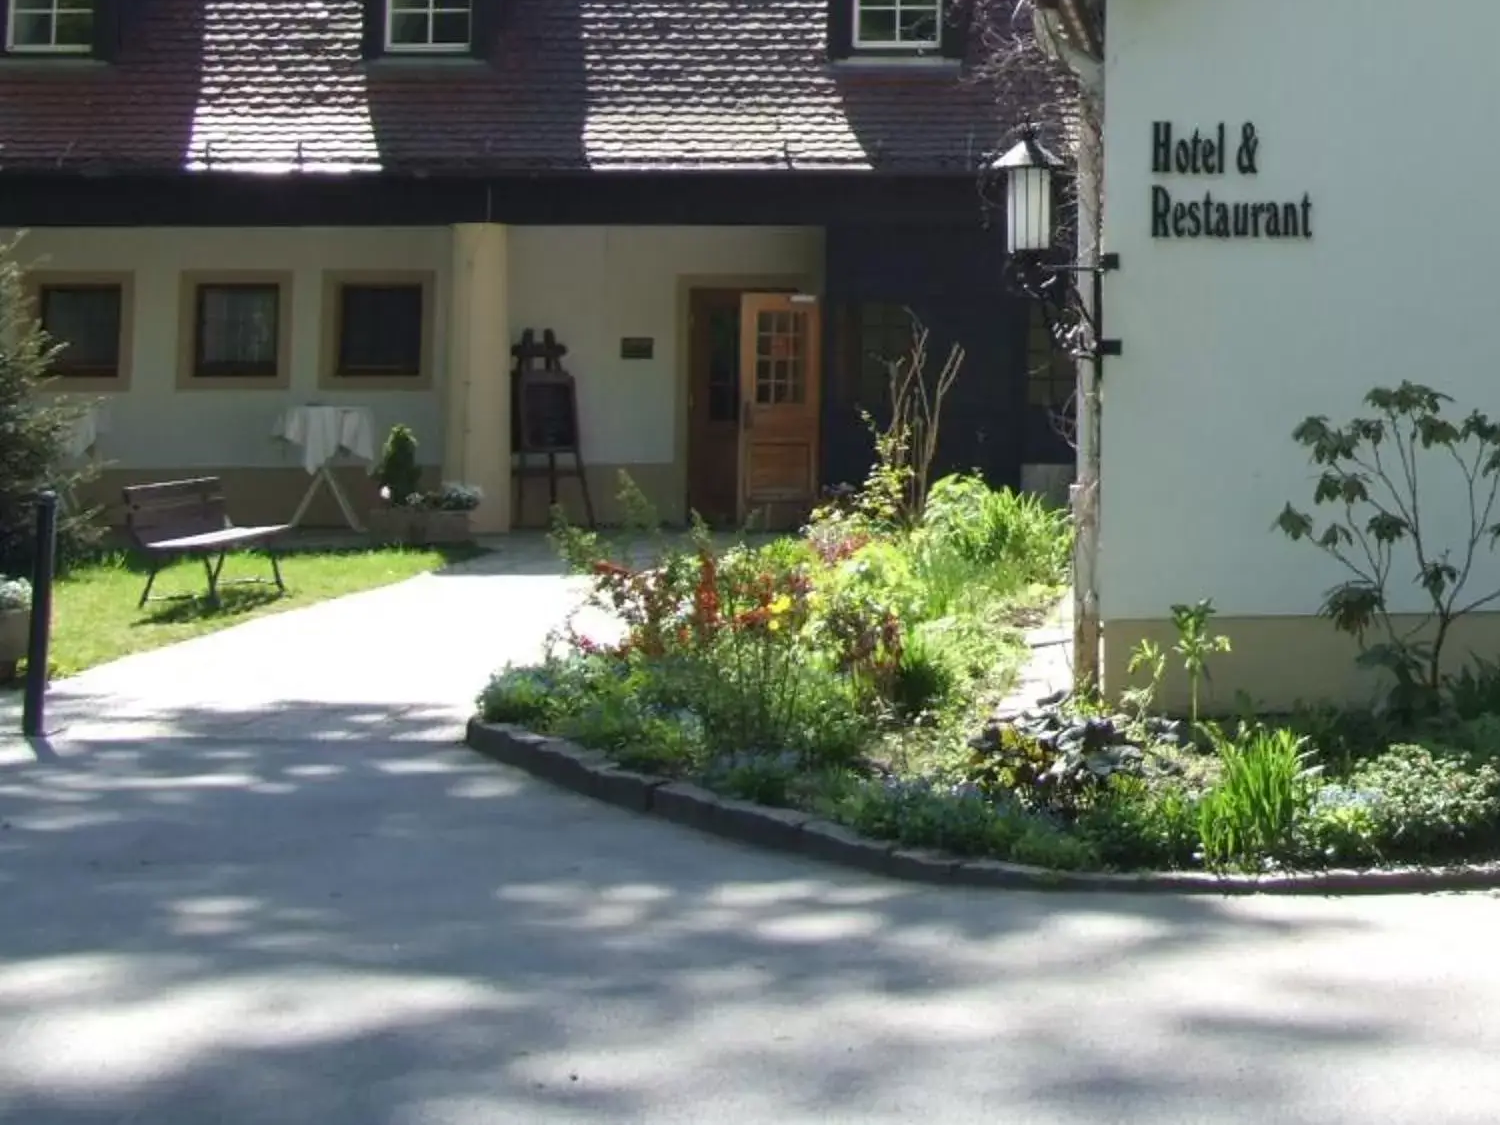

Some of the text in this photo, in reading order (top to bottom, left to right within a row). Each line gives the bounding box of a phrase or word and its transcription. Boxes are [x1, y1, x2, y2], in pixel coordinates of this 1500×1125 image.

[1151, 121, 1259, 175] Hotel &
[1151, 184, 1313, 239] Restaurant
